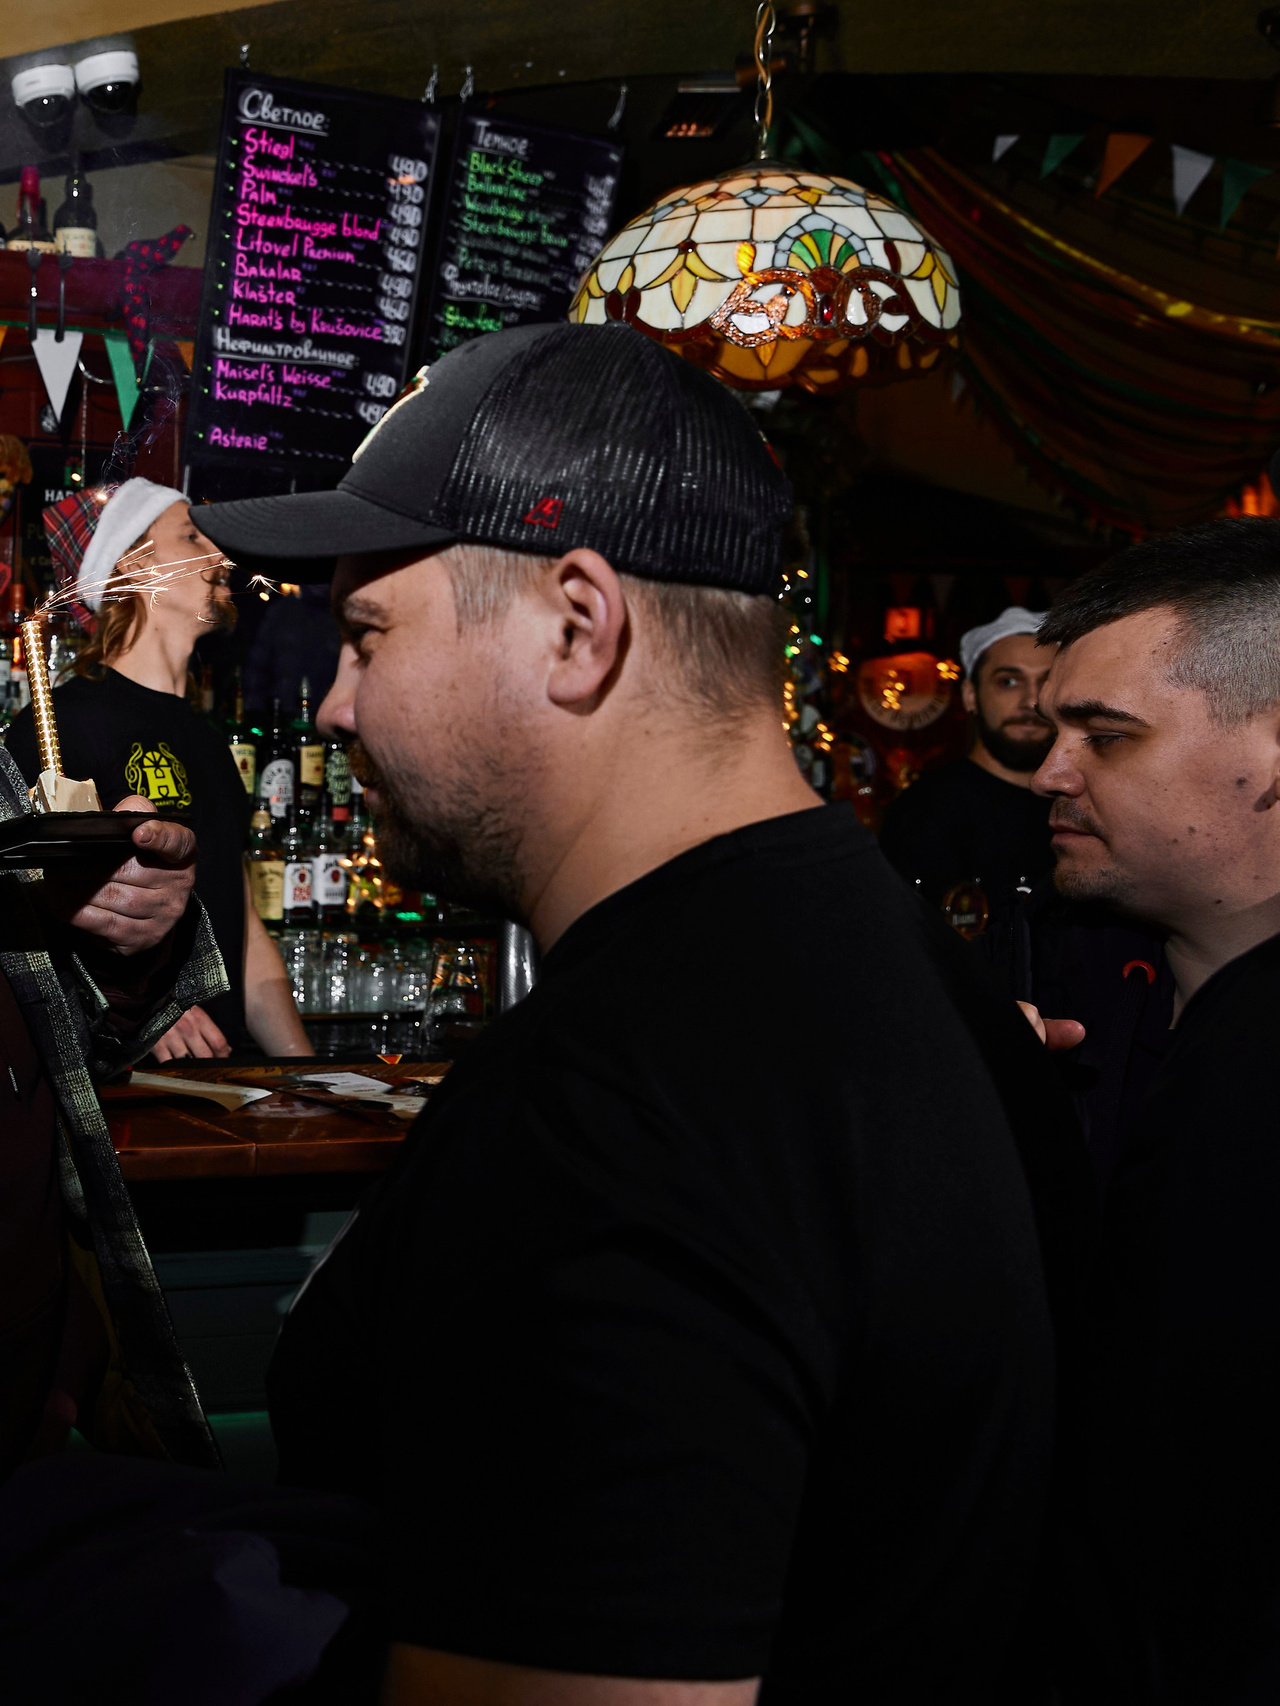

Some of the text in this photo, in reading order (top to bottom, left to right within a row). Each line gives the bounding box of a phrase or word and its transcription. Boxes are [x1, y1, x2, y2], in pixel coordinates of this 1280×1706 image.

[243, 128, 295, 160] Stiegl
[240, 179, 277, 205] Palm
[342, 212, 382, 241] blond
[236, 227, 298, 257] Litovel
[290, 311, 306, 334] by
[282, 365, 332, 389] Weisse
[209, 427, 269, 450] Asterie
